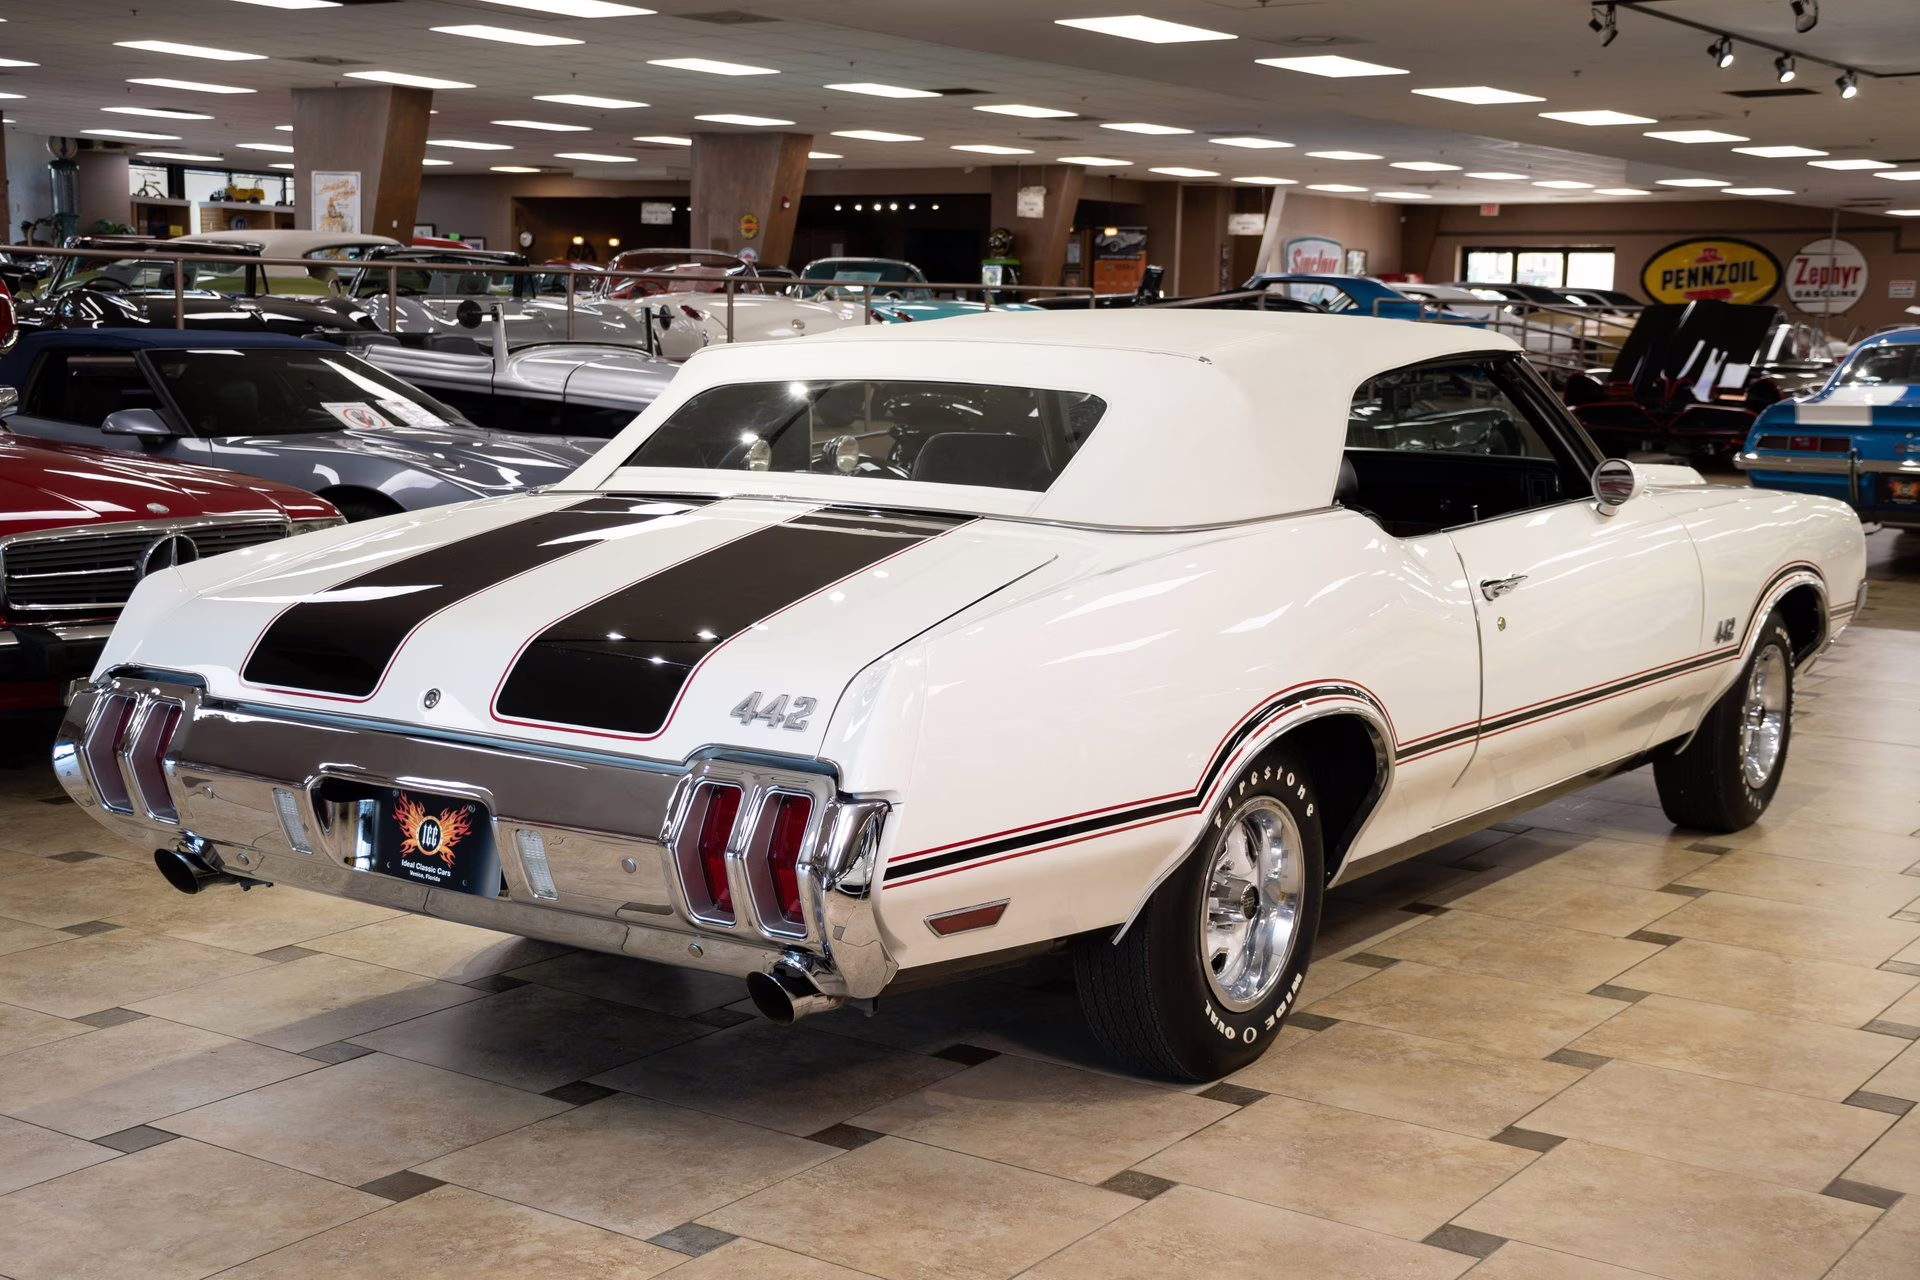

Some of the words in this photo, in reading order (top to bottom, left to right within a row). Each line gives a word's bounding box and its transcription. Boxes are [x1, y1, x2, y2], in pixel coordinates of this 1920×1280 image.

[1661, 260, 1759, 291] PENNZOIL
[1794, 256, 1862, 289] Zephyr
[1794, 290, 1857, 298] GASOLINE
[729, 690, 817, 732] 442
[1214, 765, 1314, 829] Firestone
[401, 859, 415, 868] Ideal
[416, 863, 436, 873] Classic
[437, 868, 451, 877] Cars
[409, 870, 425, 879] Venice,
[425, 874, 441, 882] Florida
